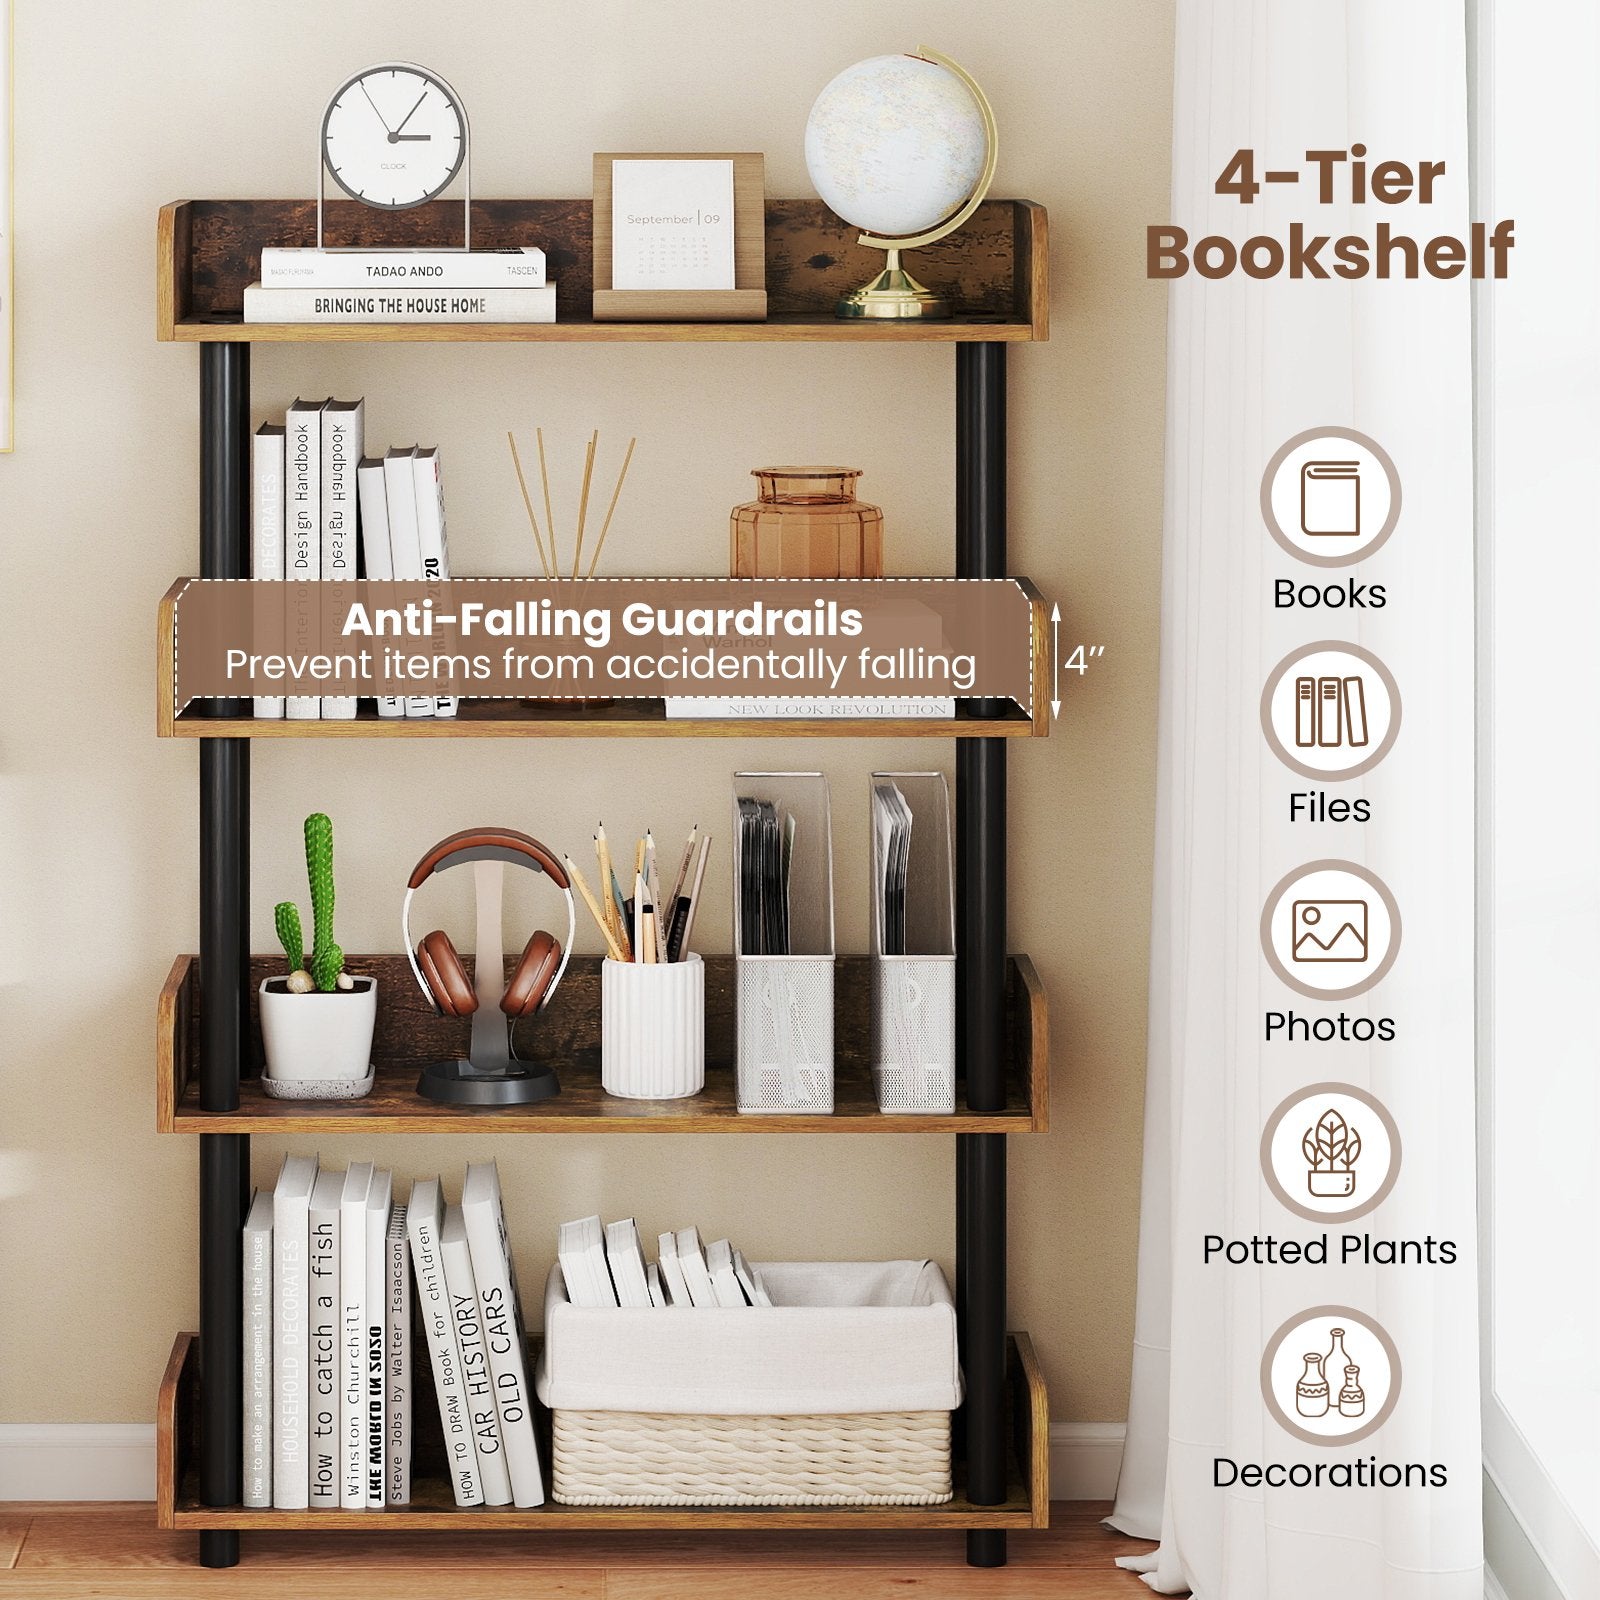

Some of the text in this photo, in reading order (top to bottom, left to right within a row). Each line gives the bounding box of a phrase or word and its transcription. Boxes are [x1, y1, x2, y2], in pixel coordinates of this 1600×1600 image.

[627, 214, 721, 226] September 09
[315, 298, 486, 313] BRINGING THE HOUSE HOME
[366, 266, 443, 277] TADAO ANDO
[294, 424, 308, 500] Handbook
[261, 473, 276, 568] DECORATES
[294, 511, 312, 568] Design
[703, 635, 772, 648] Warhol
[728, 704, 947, 715] NEW LOOK REVOLUTION
[282, 1240, 299, 1463] HOUSEHOLD DECORATES
[482, 1287, 511, 1354] CARS
[252, 1237, 266, 1499] How to make an arrangement in the house
[312, 1223, 333, 1496] How to catch a fish
[391, 1243, 405, 1501] Steve Jobs by Walter Isaacson
[418, 1225, 475, 1500] HOW TO DRAW Book for children
[453, 1294, 500, 1455] CAR HISTORY
[347, 1303, 360, 1496] Winston Churchill
[498, 1373, 524, 1423] OLD
